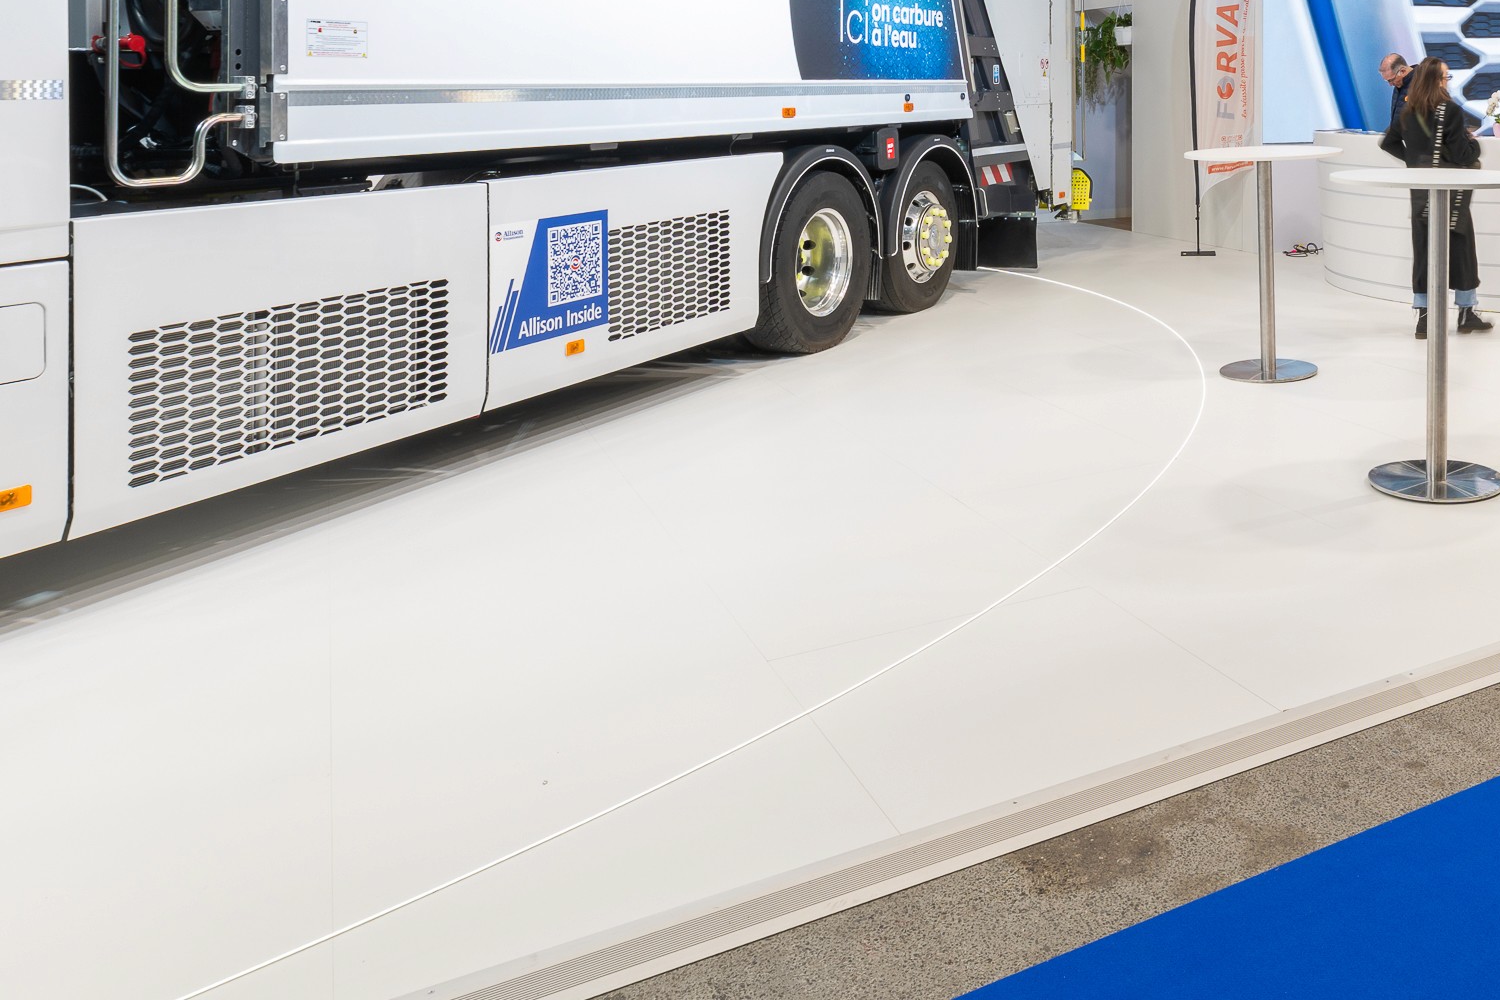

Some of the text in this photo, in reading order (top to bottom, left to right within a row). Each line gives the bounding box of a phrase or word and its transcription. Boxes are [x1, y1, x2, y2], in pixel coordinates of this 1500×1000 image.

[871, 3, 944, 28] on carbure
[871, 21, 917, 48] à l'eau
[518, 302, 602, 340] Allison Inside
